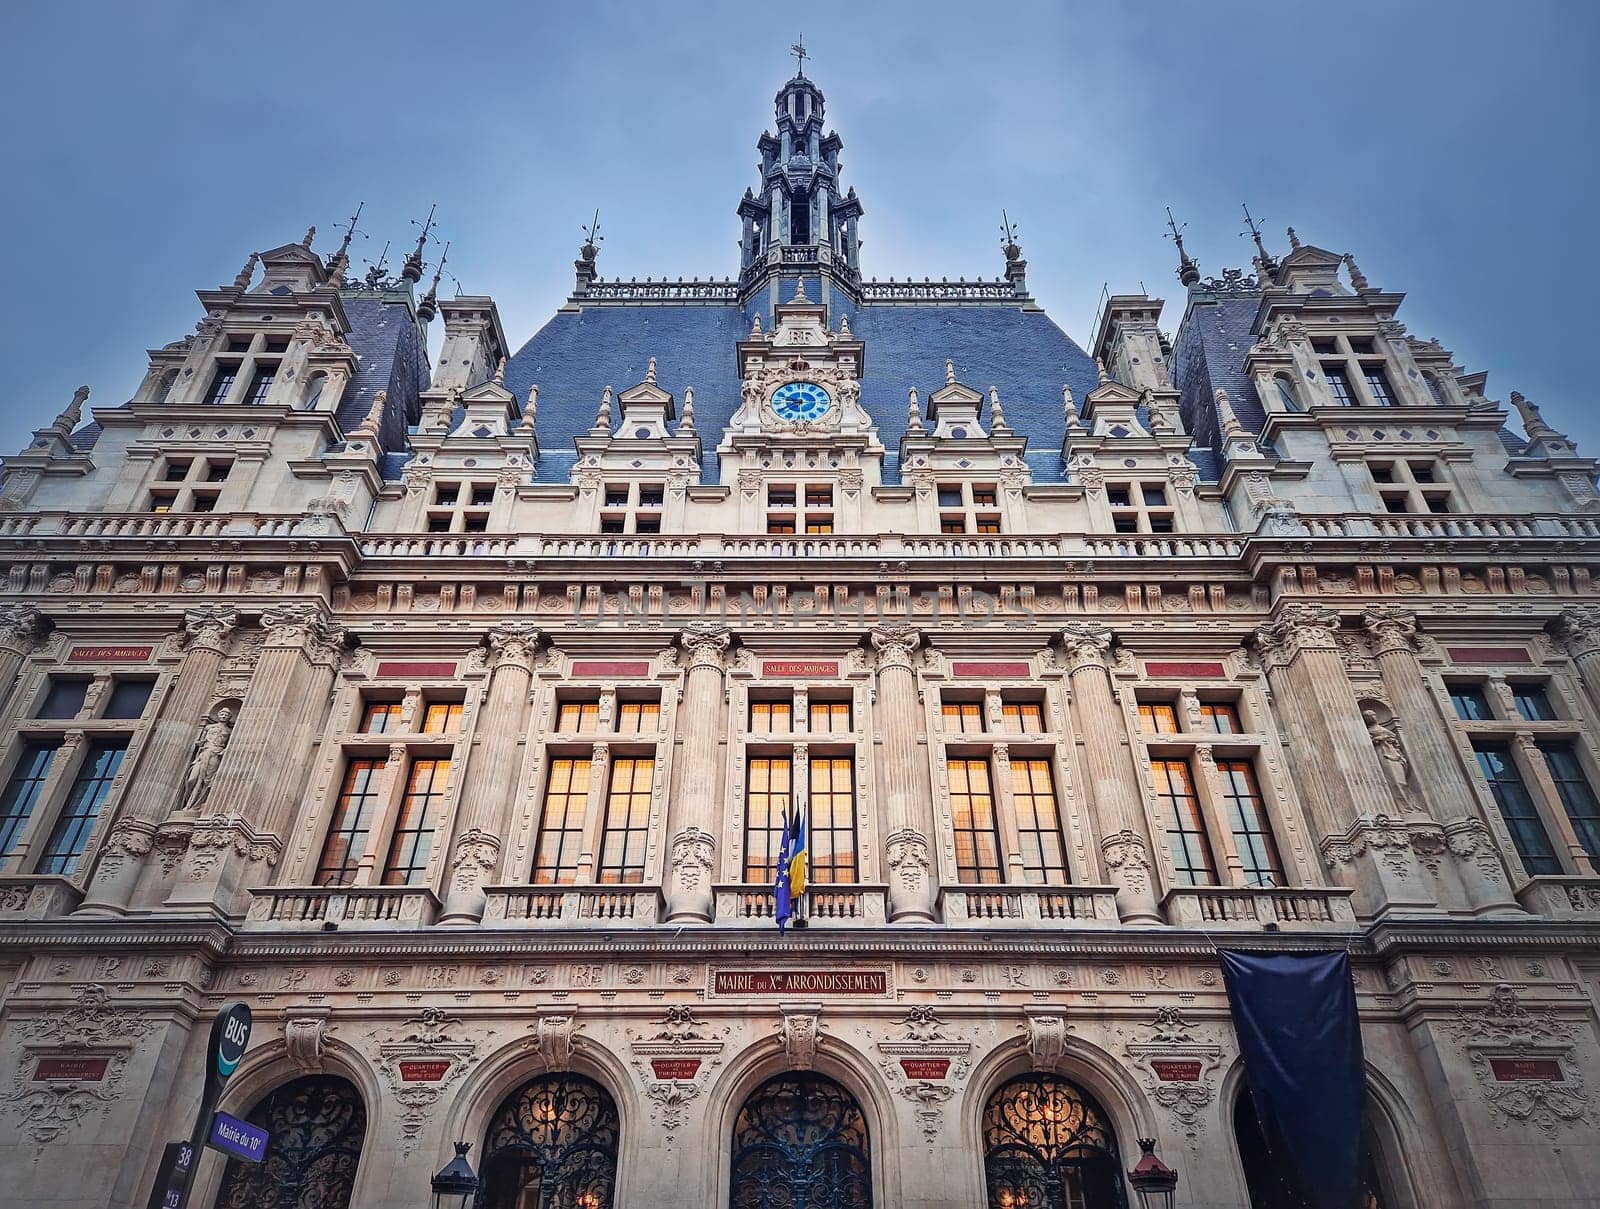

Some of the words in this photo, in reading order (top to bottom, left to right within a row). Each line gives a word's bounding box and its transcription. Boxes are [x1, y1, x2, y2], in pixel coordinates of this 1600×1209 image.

[766, 665, 785, 673] SALLE
[789, 665, 802, 673] DES
[803, 665, 835, 674] MARIAGES
[718, 975, 755, 990] MAIRIE
[757, 981, 767, 989] DU
[786, 974, 883, 990] ARRONDISSEMENT
[225, 1016, 248, 1047] BUS
[217, 1122, 240, 1143] Mairie
[239, 1132, 250, 1147] du
[178, 1147, 192, 1167] 38
